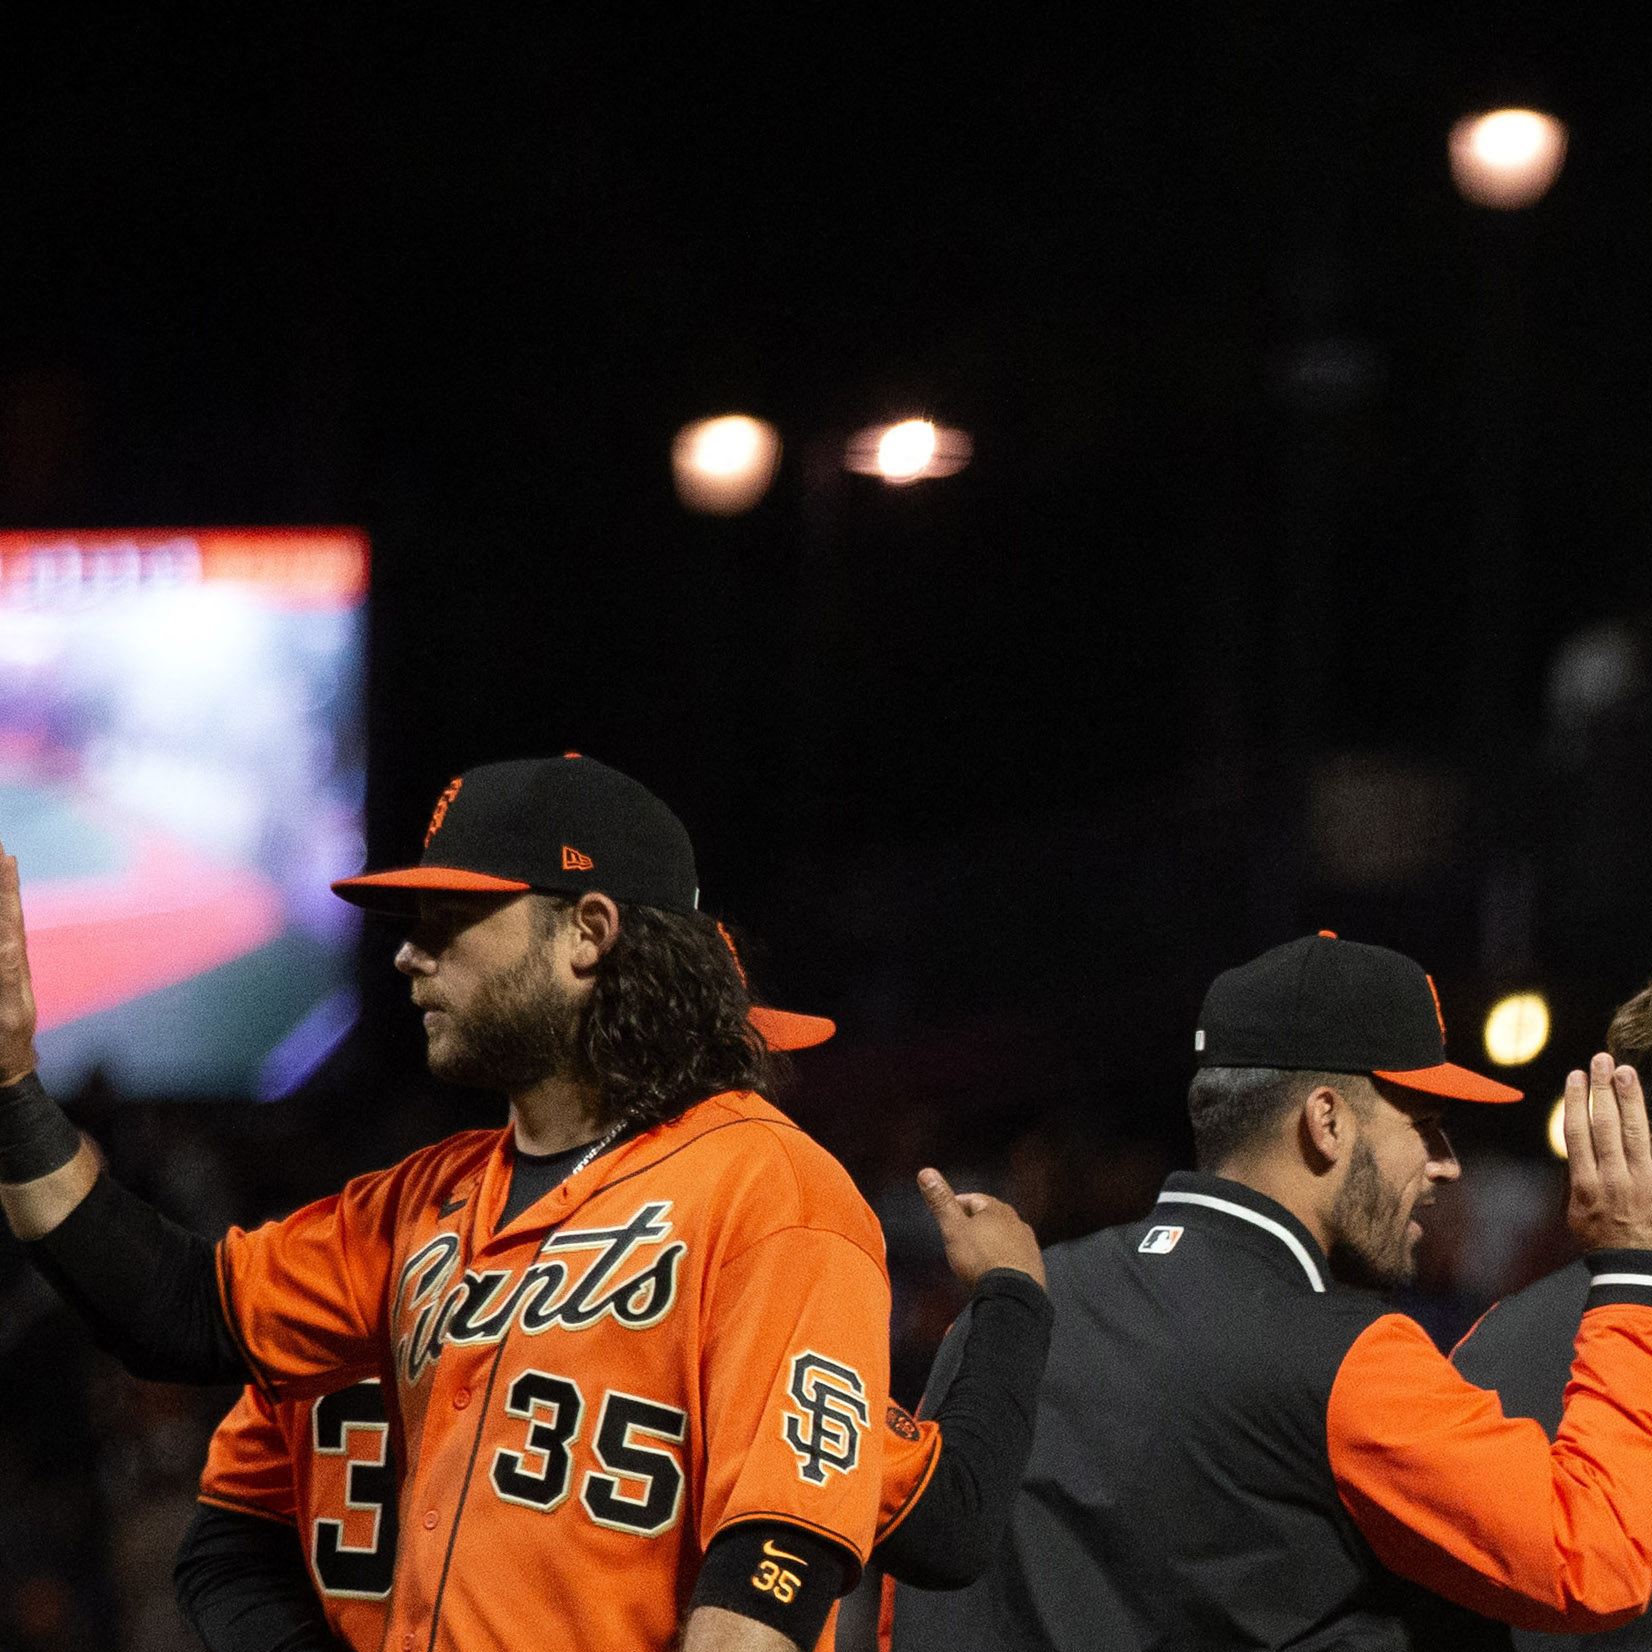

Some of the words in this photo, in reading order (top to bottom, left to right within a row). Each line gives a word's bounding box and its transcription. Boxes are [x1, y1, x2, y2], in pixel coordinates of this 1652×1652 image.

[490, 1369, 688, 1538] 35
[784, 1349, 871, 1487] SF
[750, 1558, 802, 1604] 35
